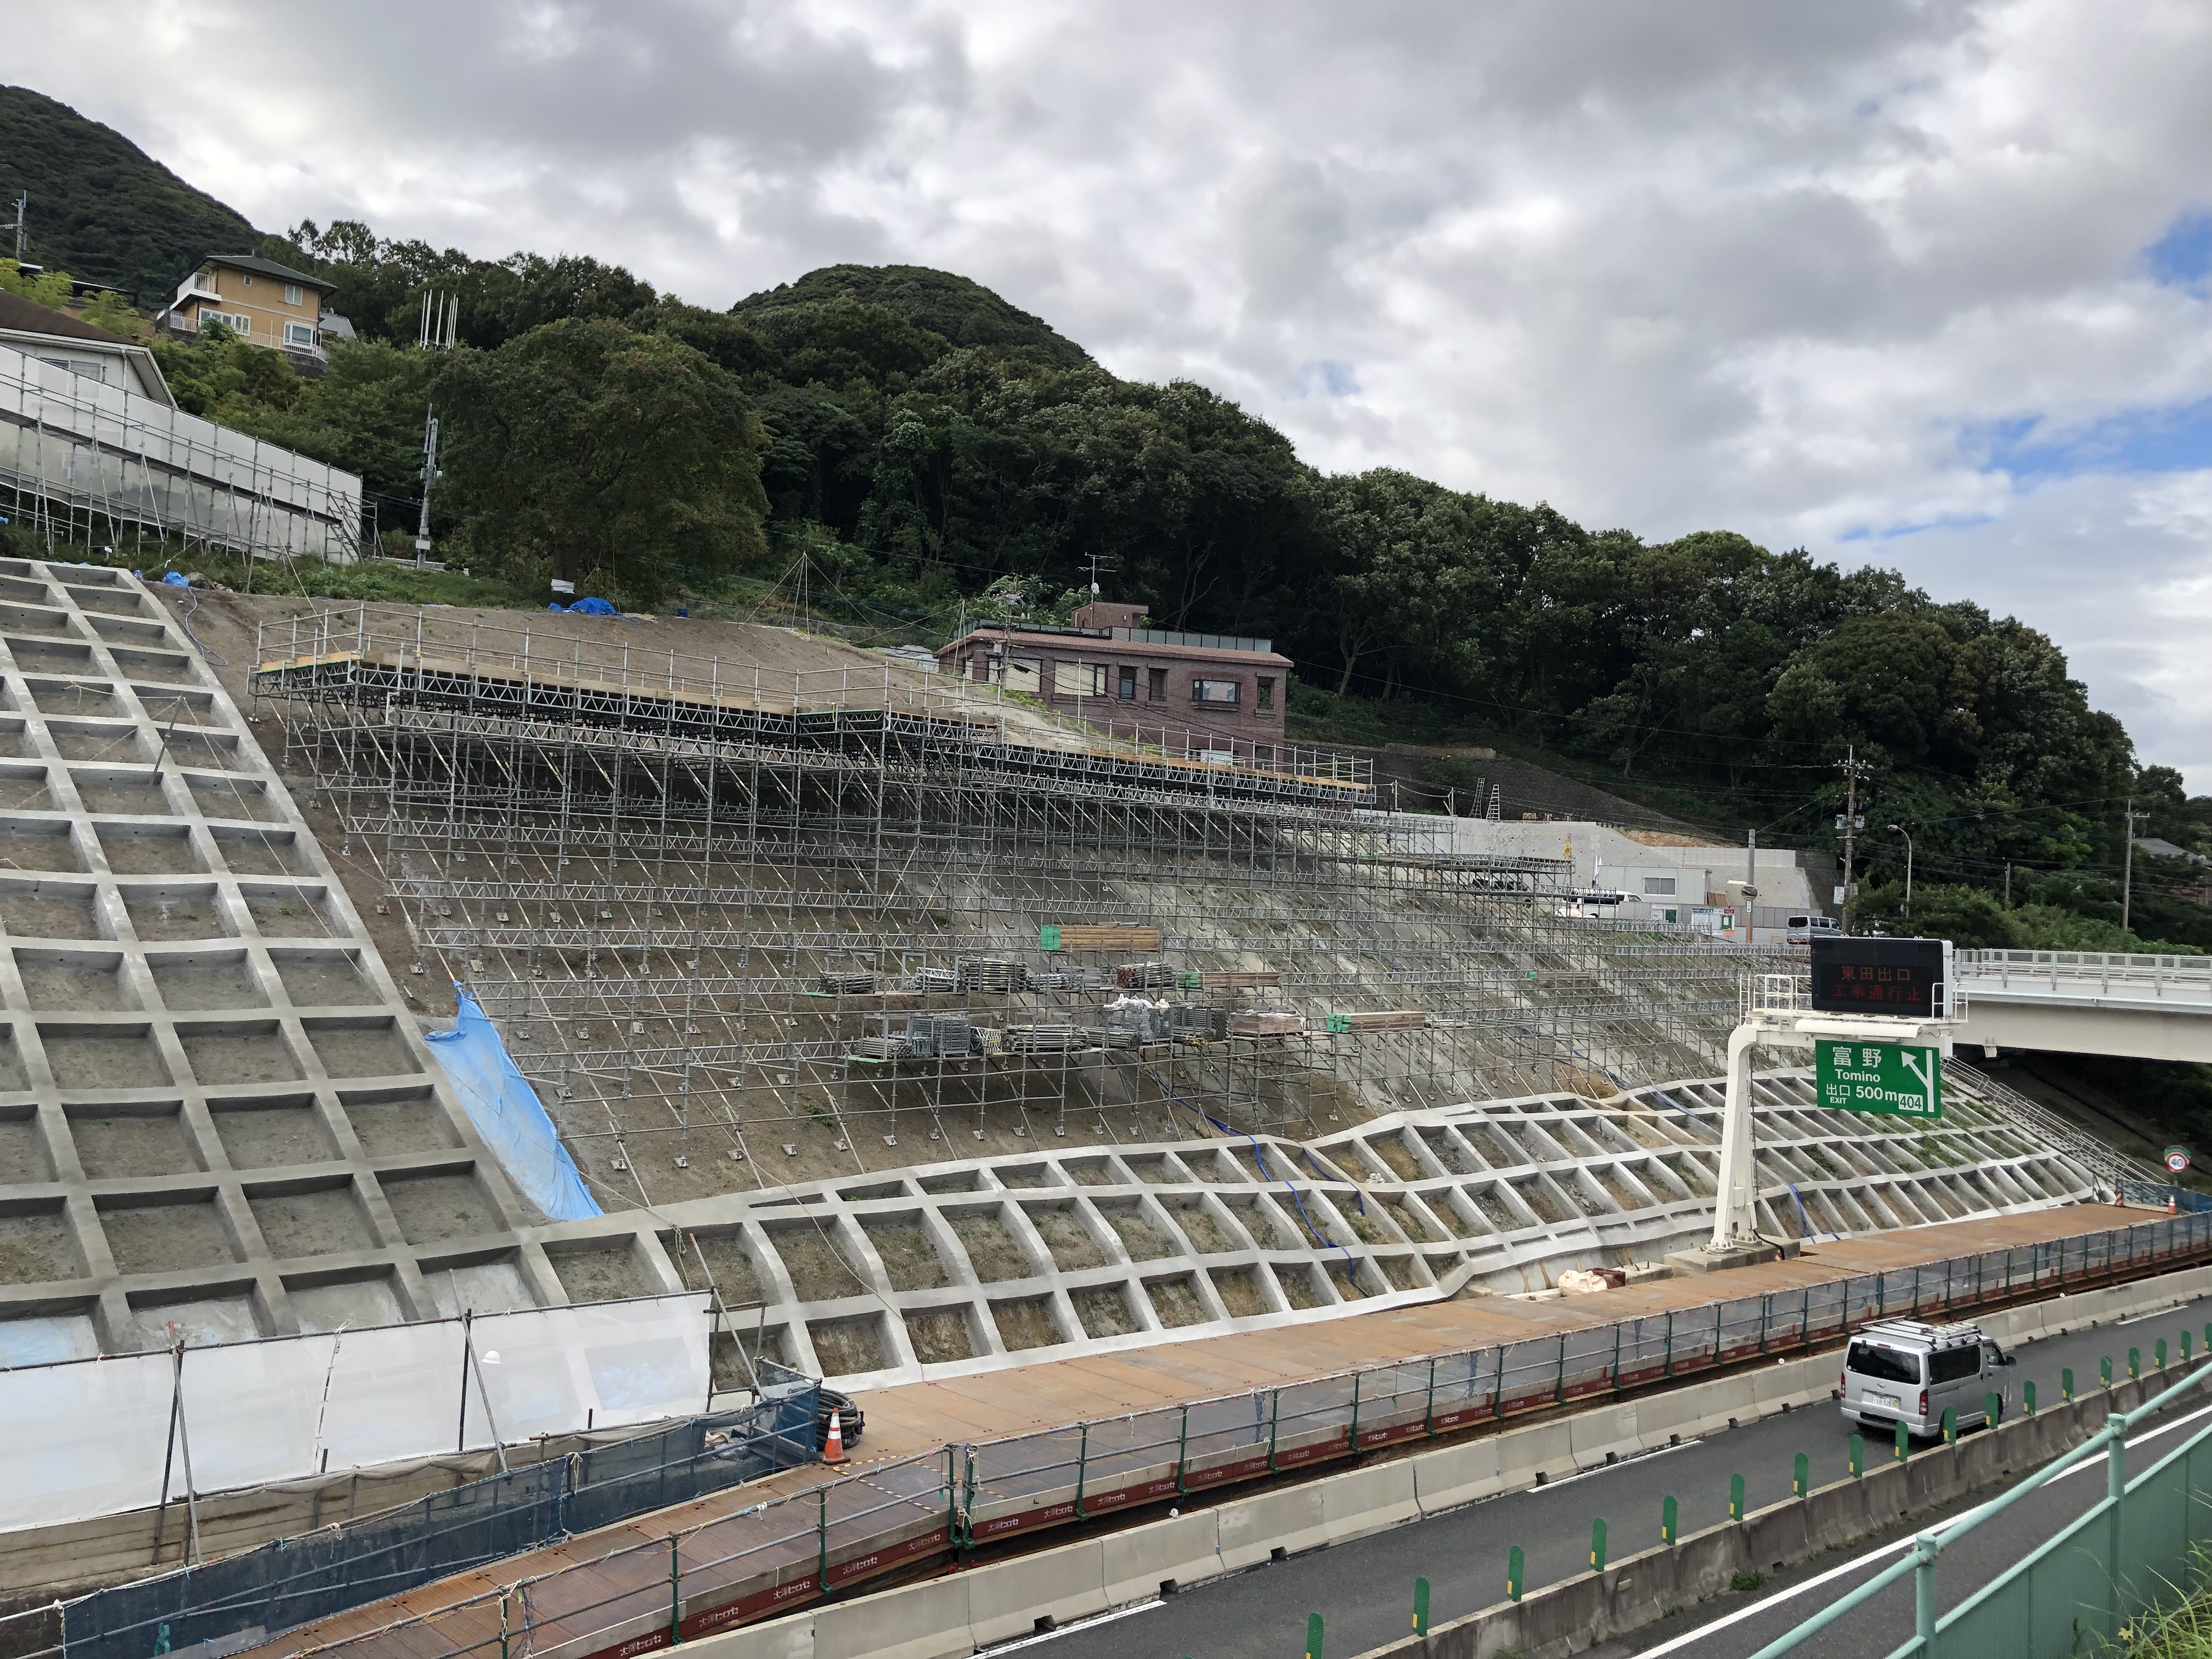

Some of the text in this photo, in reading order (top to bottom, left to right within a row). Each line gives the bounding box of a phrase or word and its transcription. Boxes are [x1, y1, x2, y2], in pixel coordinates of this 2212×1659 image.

[1841, 966, 1910, 981] 東田出口
[1833, 984, 1921, 1001] 工事通行止
[1832, 1046, 1882, 1068] 富野
[1835, 1068, 1881, 1082] Tomino
[1826, 1083, 1850, 1097] 出口
[1830, 1096, 1847, 1104] EXIT
[1899, 1096, 1922, 1109] 404
[2171, 1158, 2183, 1167] 40
